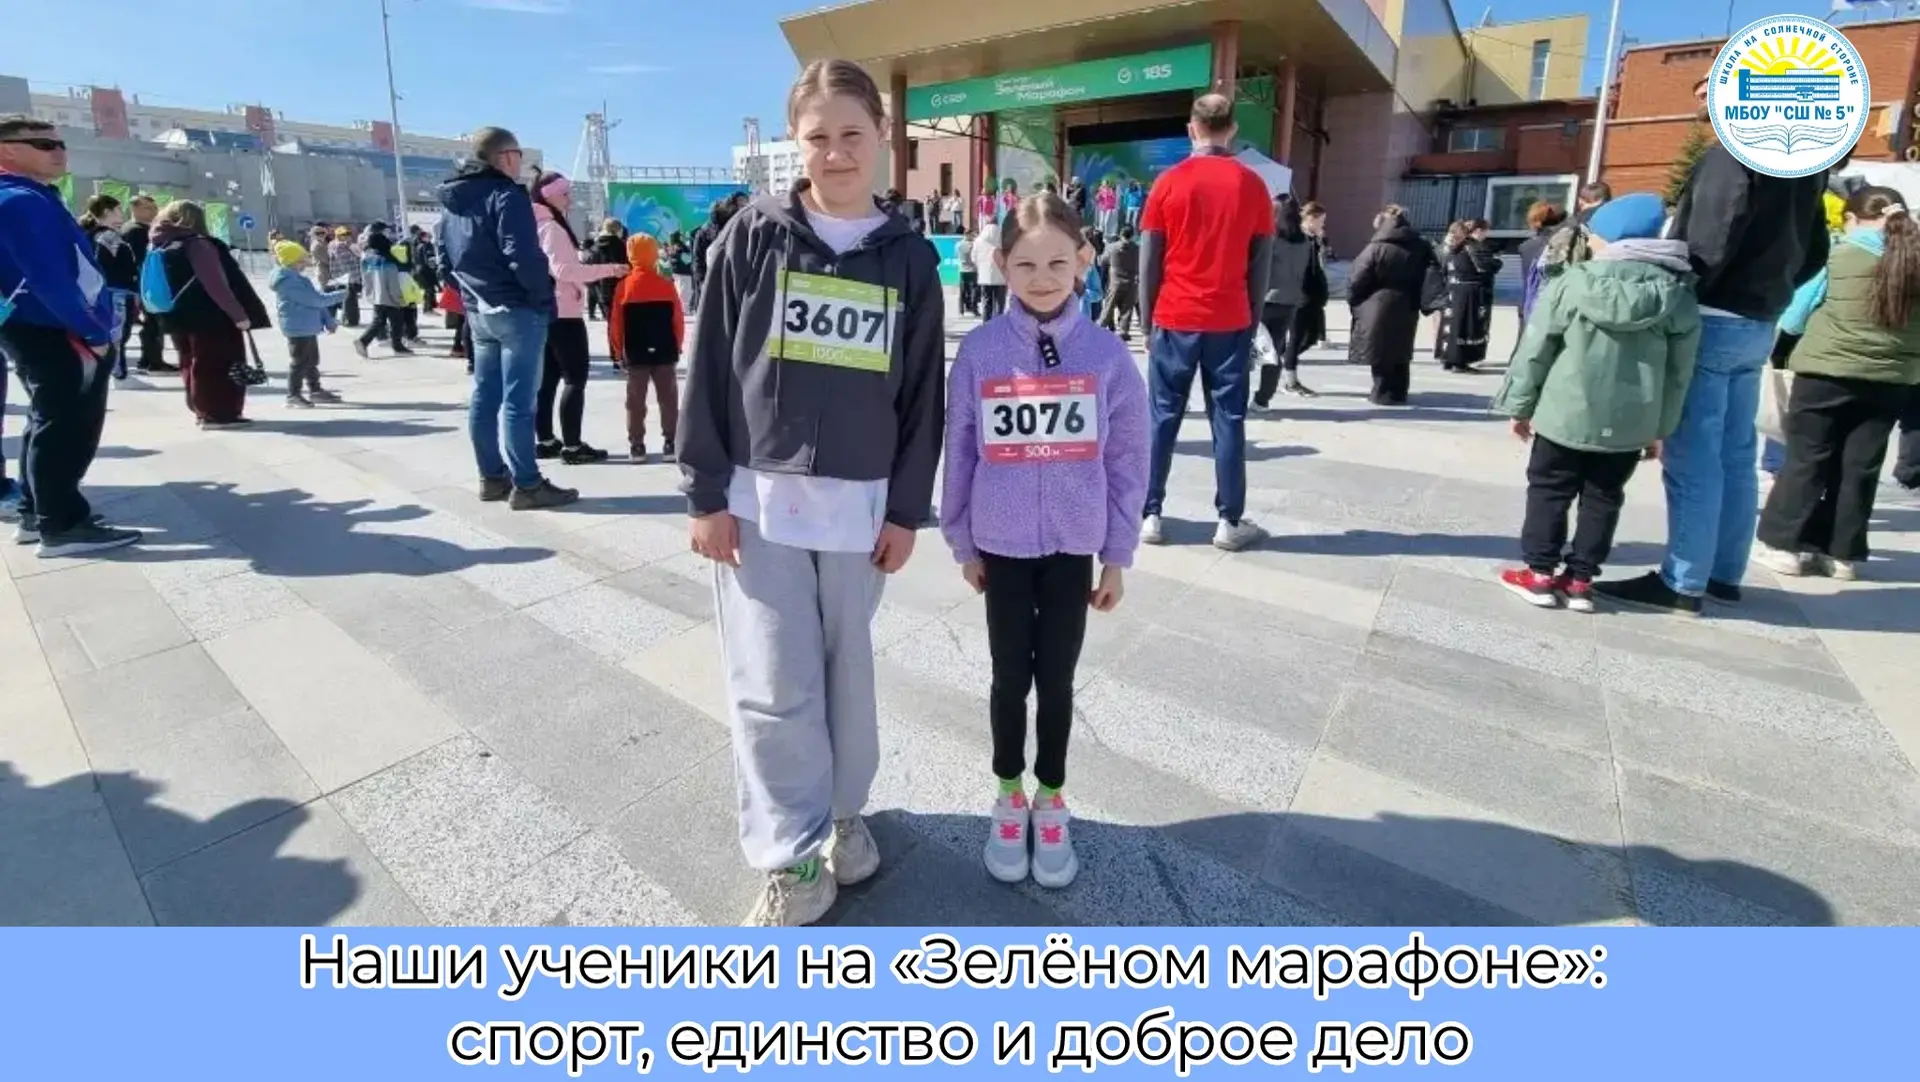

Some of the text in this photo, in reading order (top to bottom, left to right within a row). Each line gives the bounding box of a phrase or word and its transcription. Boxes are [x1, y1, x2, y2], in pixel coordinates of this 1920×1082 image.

[1142, 63, 1172, 80] 185
[786, 299, 885, 344] 3607
[993, 401, 1085, 437] 3076
[1025, 445, 1051, 457] 500
